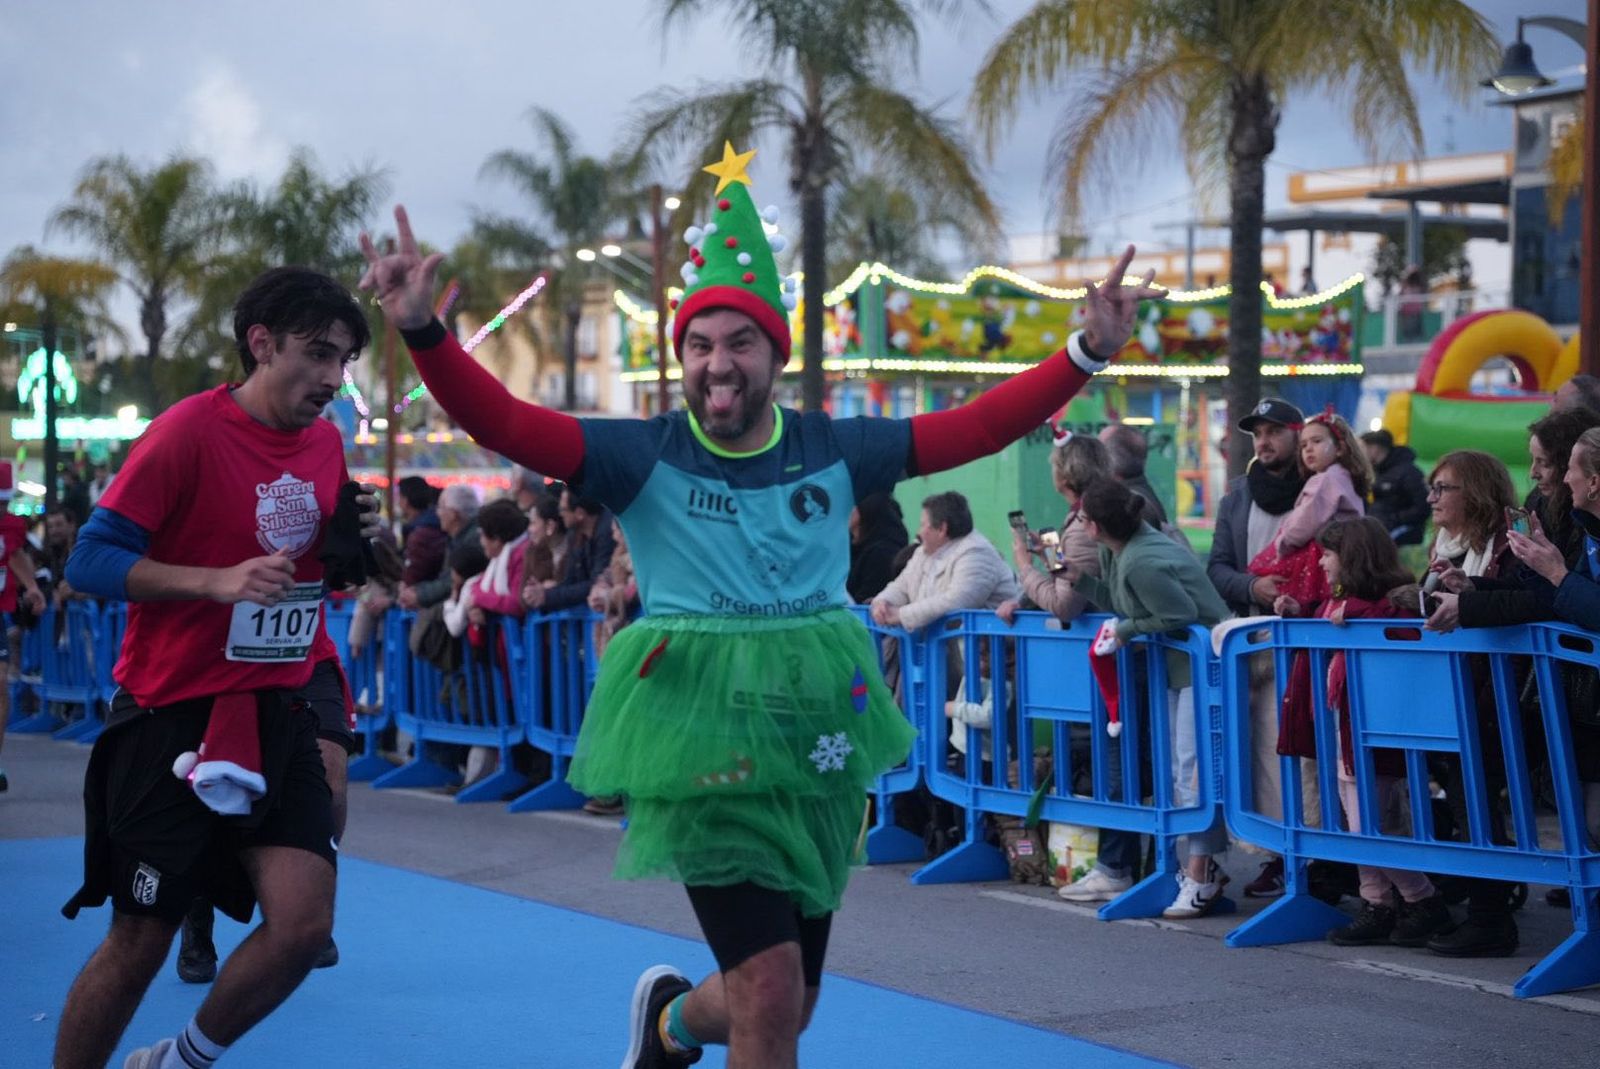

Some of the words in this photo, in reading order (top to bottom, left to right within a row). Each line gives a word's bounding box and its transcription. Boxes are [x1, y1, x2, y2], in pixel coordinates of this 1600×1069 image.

[256, 481, 315, 499] Carrera
[275, 498, 306, 513] San
[258, 510, 321, 532] Silvestre
[251, 608, 318, 637] 1107
